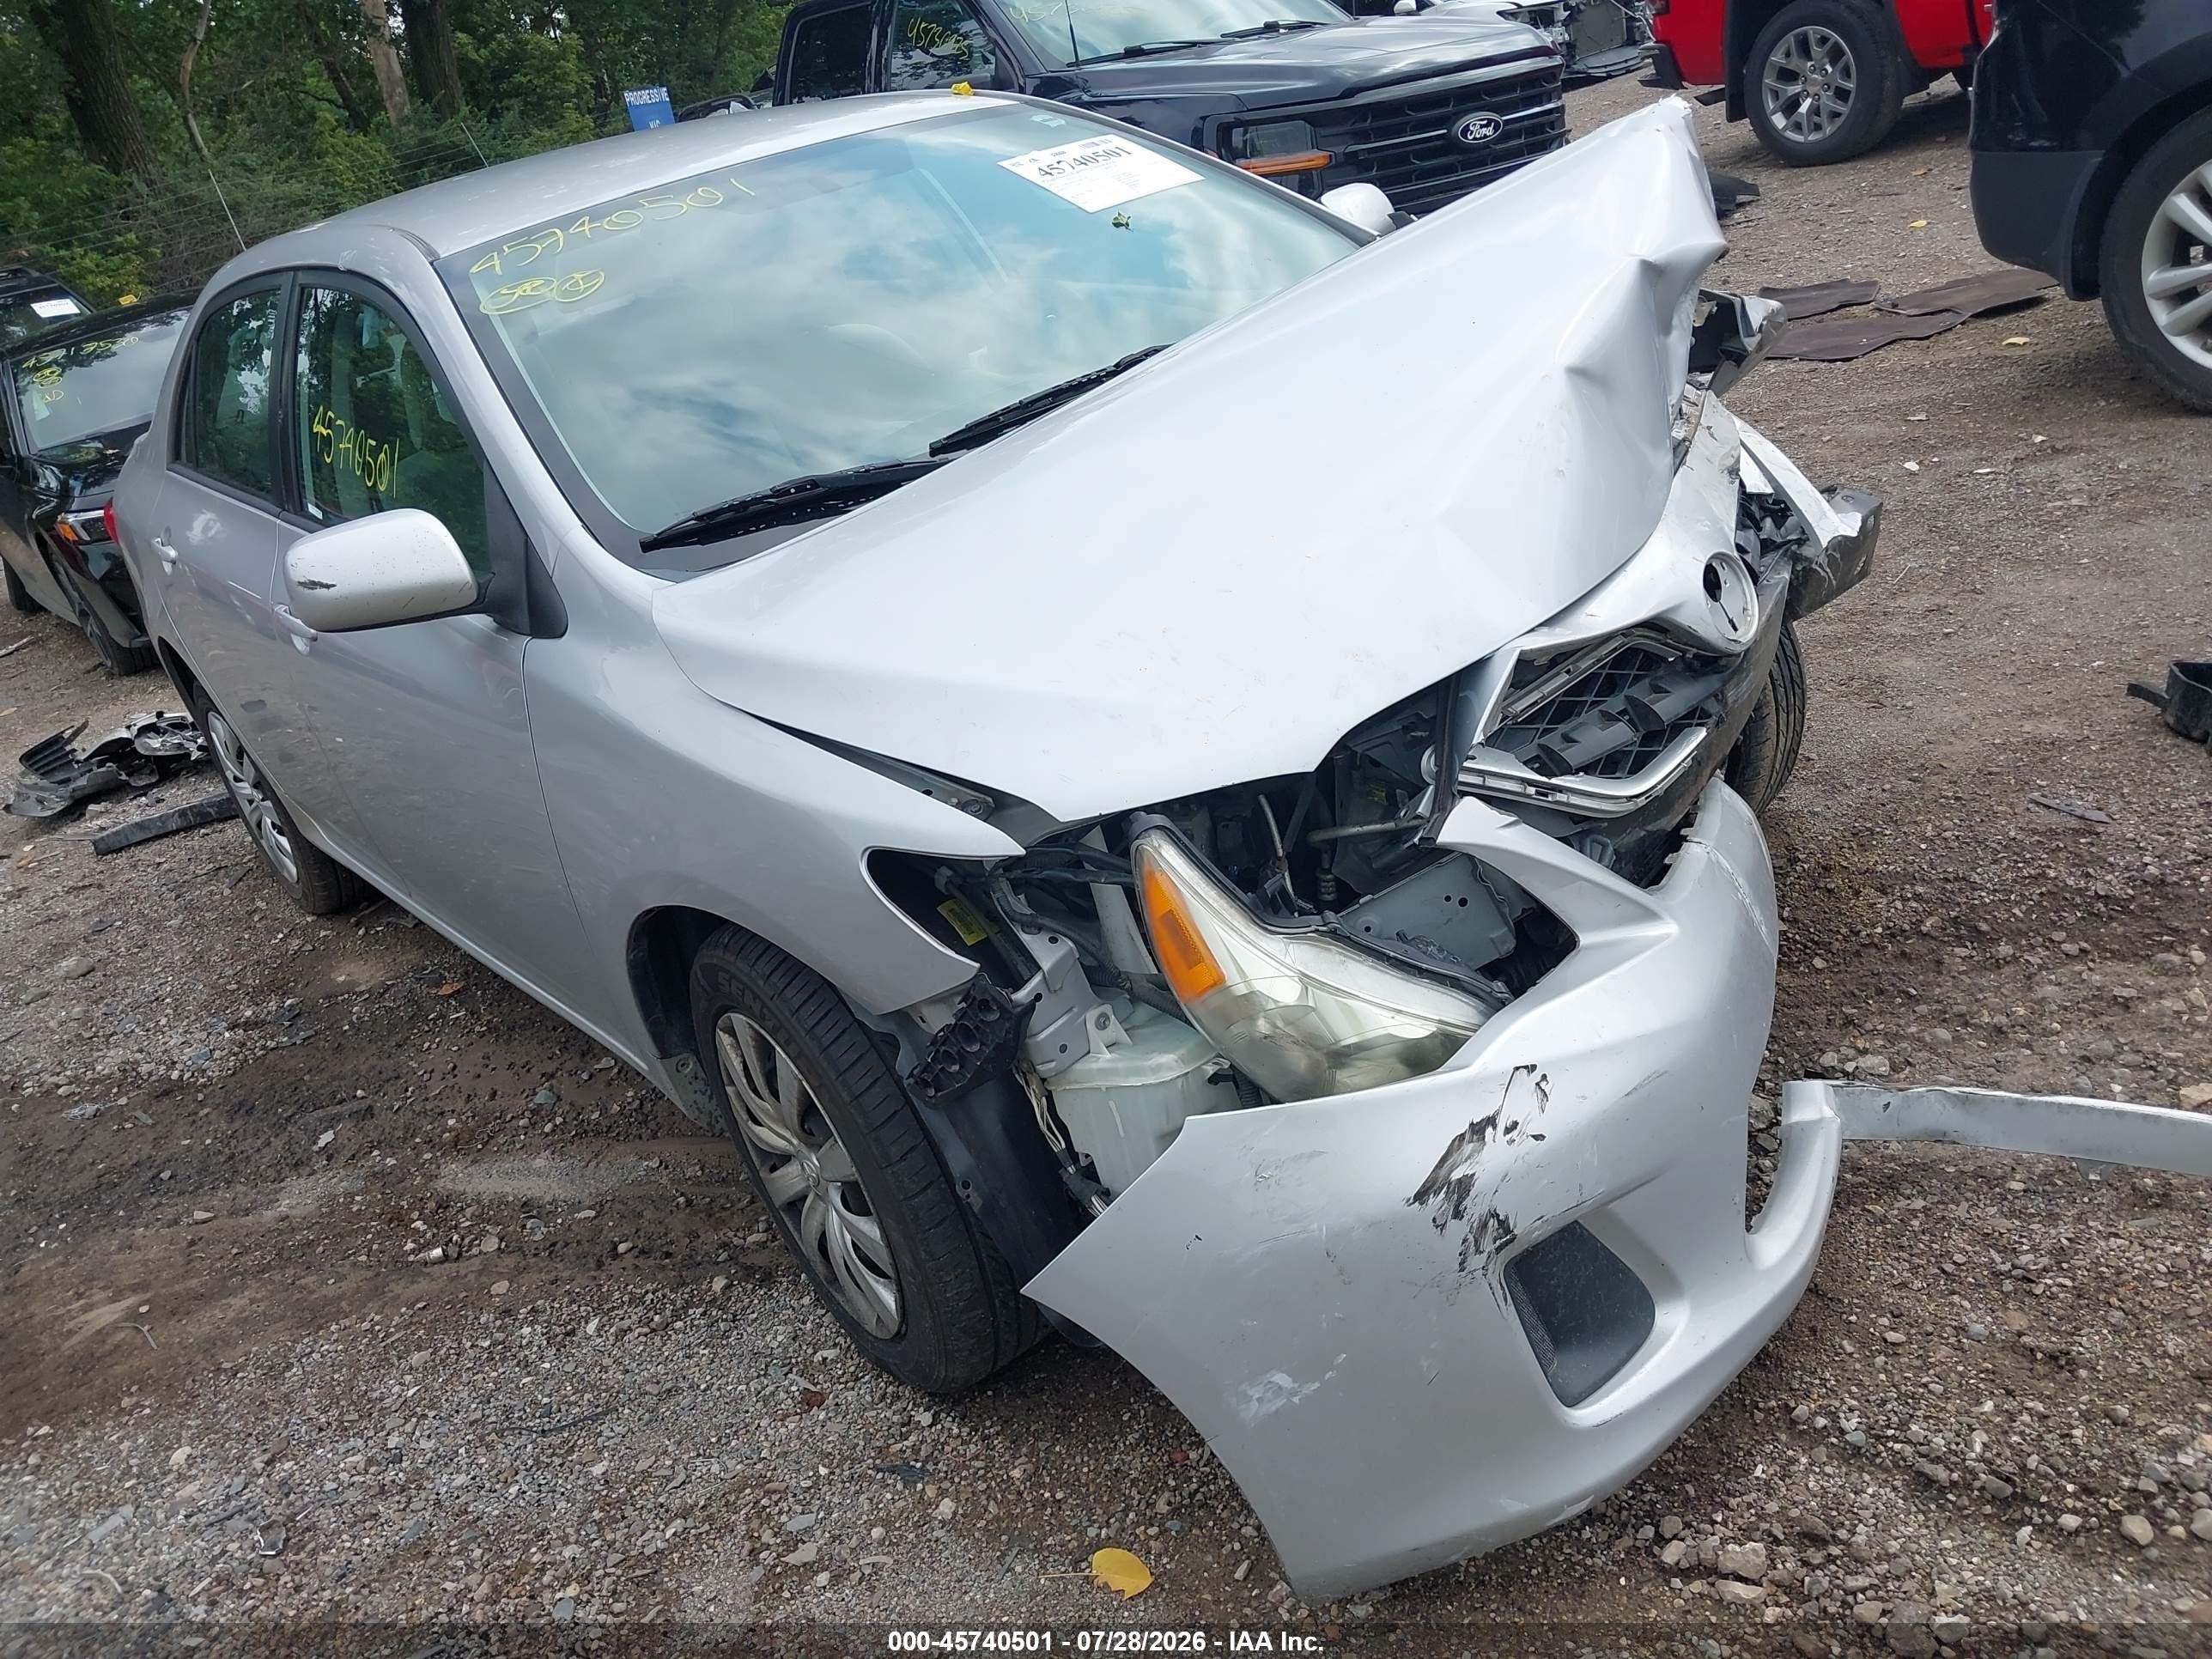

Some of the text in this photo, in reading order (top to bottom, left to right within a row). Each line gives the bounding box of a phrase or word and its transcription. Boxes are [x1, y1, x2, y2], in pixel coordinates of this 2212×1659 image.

[623, 87, 670, 106] PROGRESSIVE
[1468, 119, 1495, 140] Ford
[1037, 146, 1133, 177] 45740501
[469, 178, 756, 276] 45740501
[313, 404, 399, 499] 45740501
